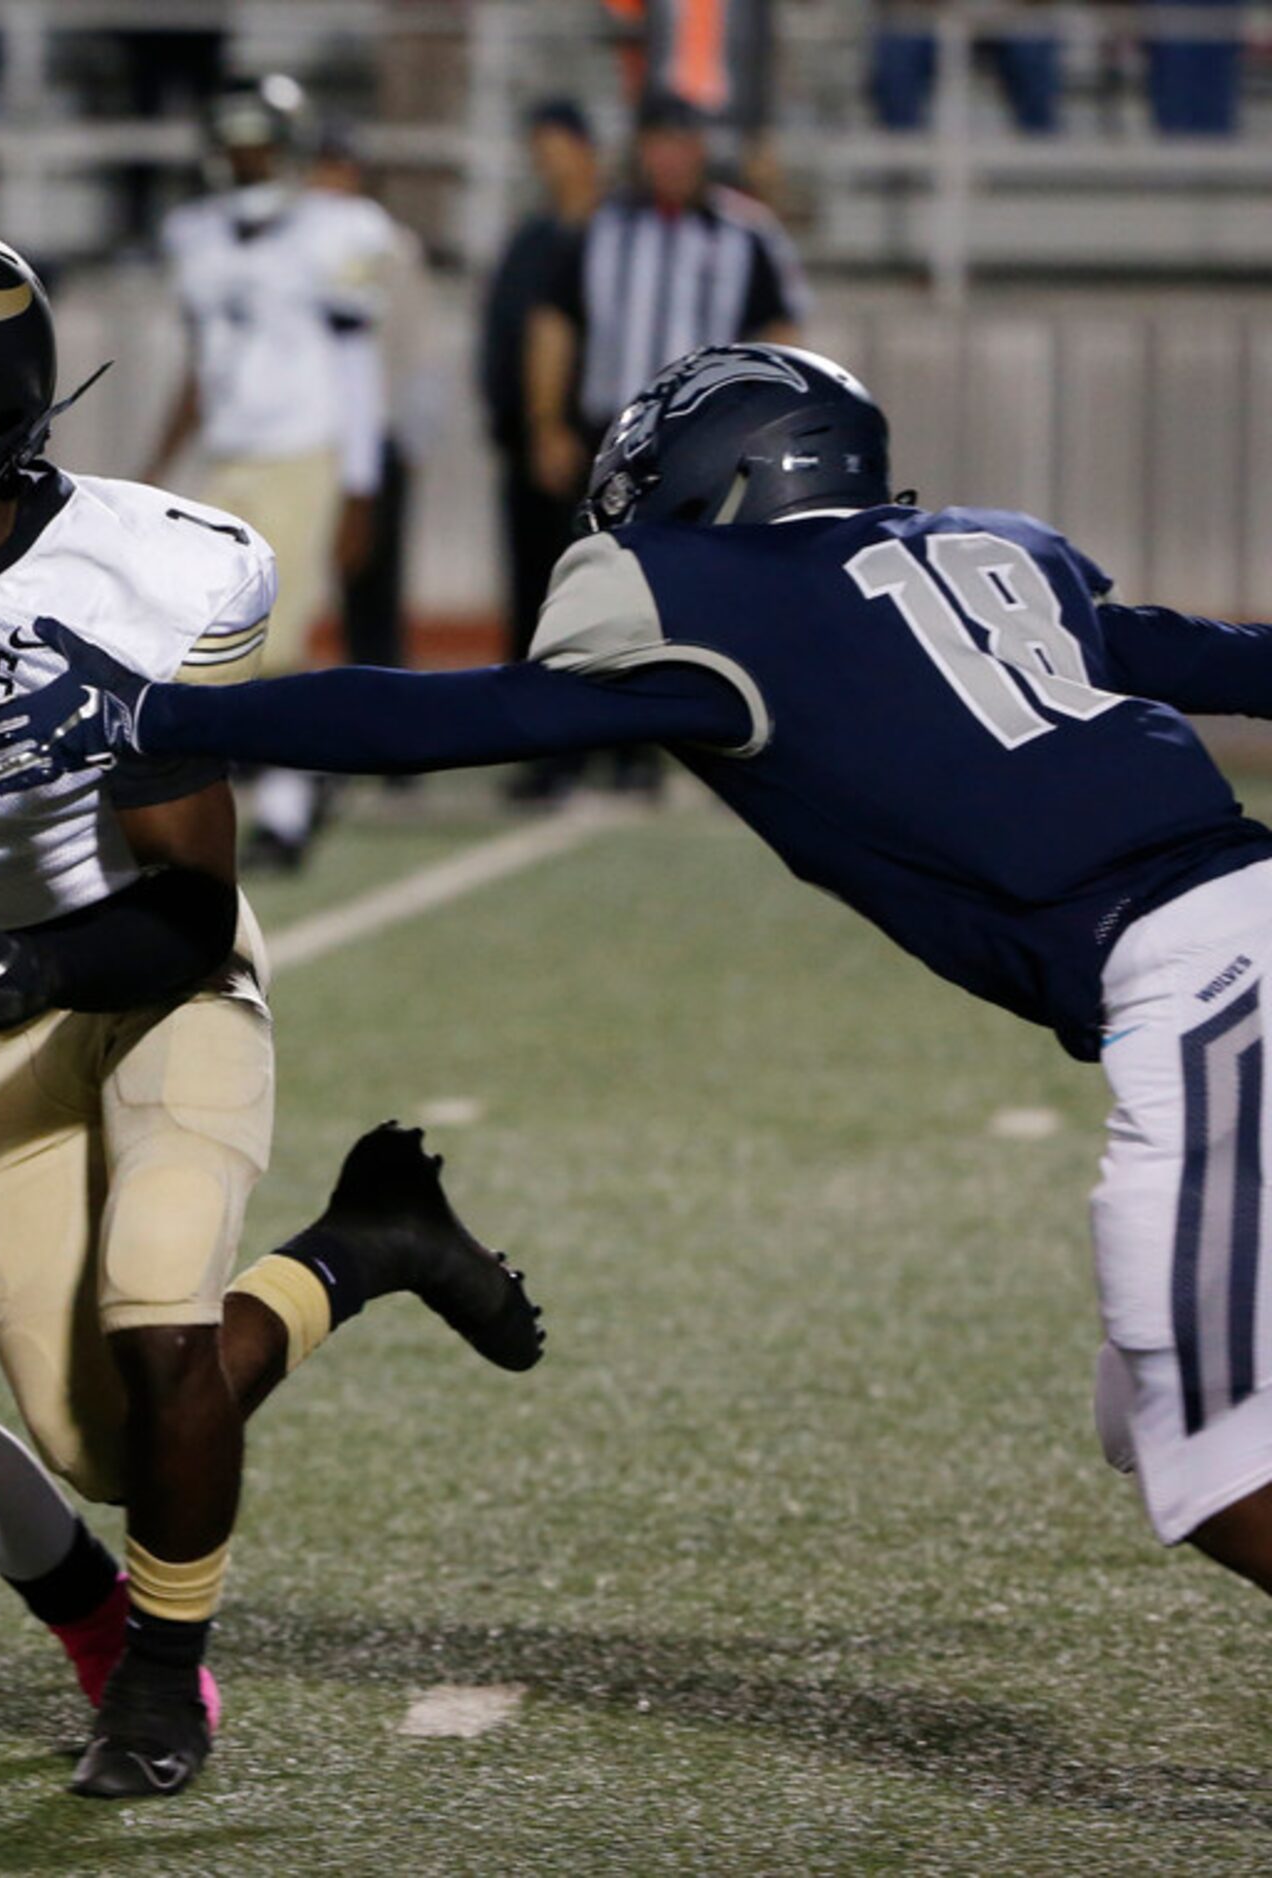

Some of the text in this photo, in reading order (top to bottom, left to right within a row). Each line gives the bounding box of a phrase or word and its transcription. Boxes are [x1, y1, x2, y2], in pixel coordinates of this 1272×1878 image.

[165, 508, 251, 545] 1
[843, 532, 1127, 750] 18
[1195, 954, 1252, 1002] WOLVES
